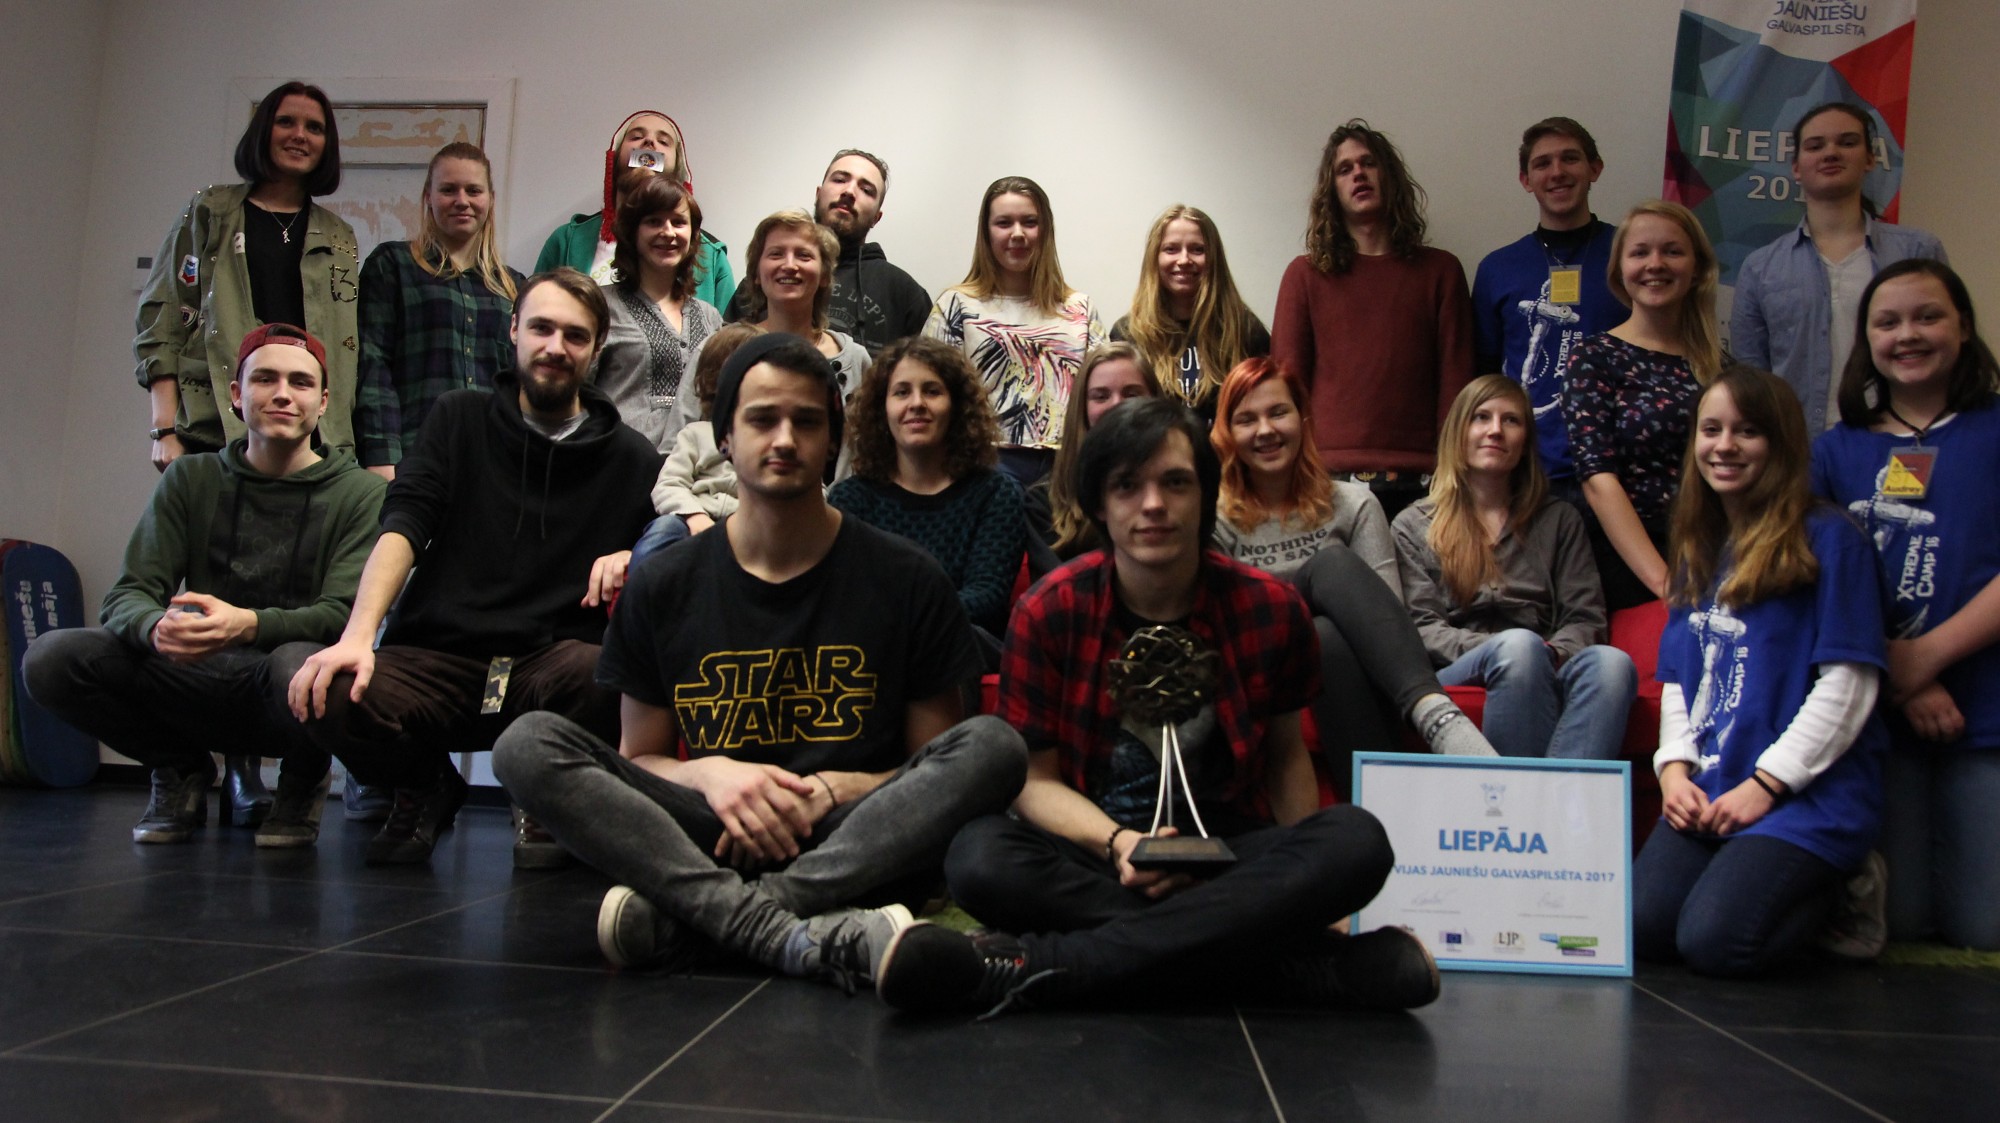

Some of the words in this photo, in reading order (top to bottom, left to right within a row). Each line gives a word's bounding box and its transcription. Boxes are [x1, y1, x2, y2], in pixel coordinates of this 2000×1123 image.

[1773, 1, 1867, 21] JAUNIEŠU
[1766, 19, 1866, 36] GALVASPILSĒTA
[1698, 125, 1891, 171] LIEPA
[1747, 175, 1807, 202] 201
[1553, 329, 1572, 379] XTREME
[1241, 528, 1328, 556] NOTHING
[1250, 555, 1277, 567] TO
[1285, 542, 1322, 562] SAY
[1896, 534, 1923, 602] XTREME
[40, 580, 58, 627] māja
[674, 645, 877, 702] STAR
[675, 692, 876, 749] WARS
[1438, 827, 1548, 854] LIEPĀJA
[1393, 864, 1427, 876] VIJAS
[1430, 865, 1488, 878] JAUNIEŠU
[1491, 868, 1583, 881] GALVASPILSĒTA
[1585, 871, 1615, 882] 2017
[1498, 931, 1520, 946] LJP
